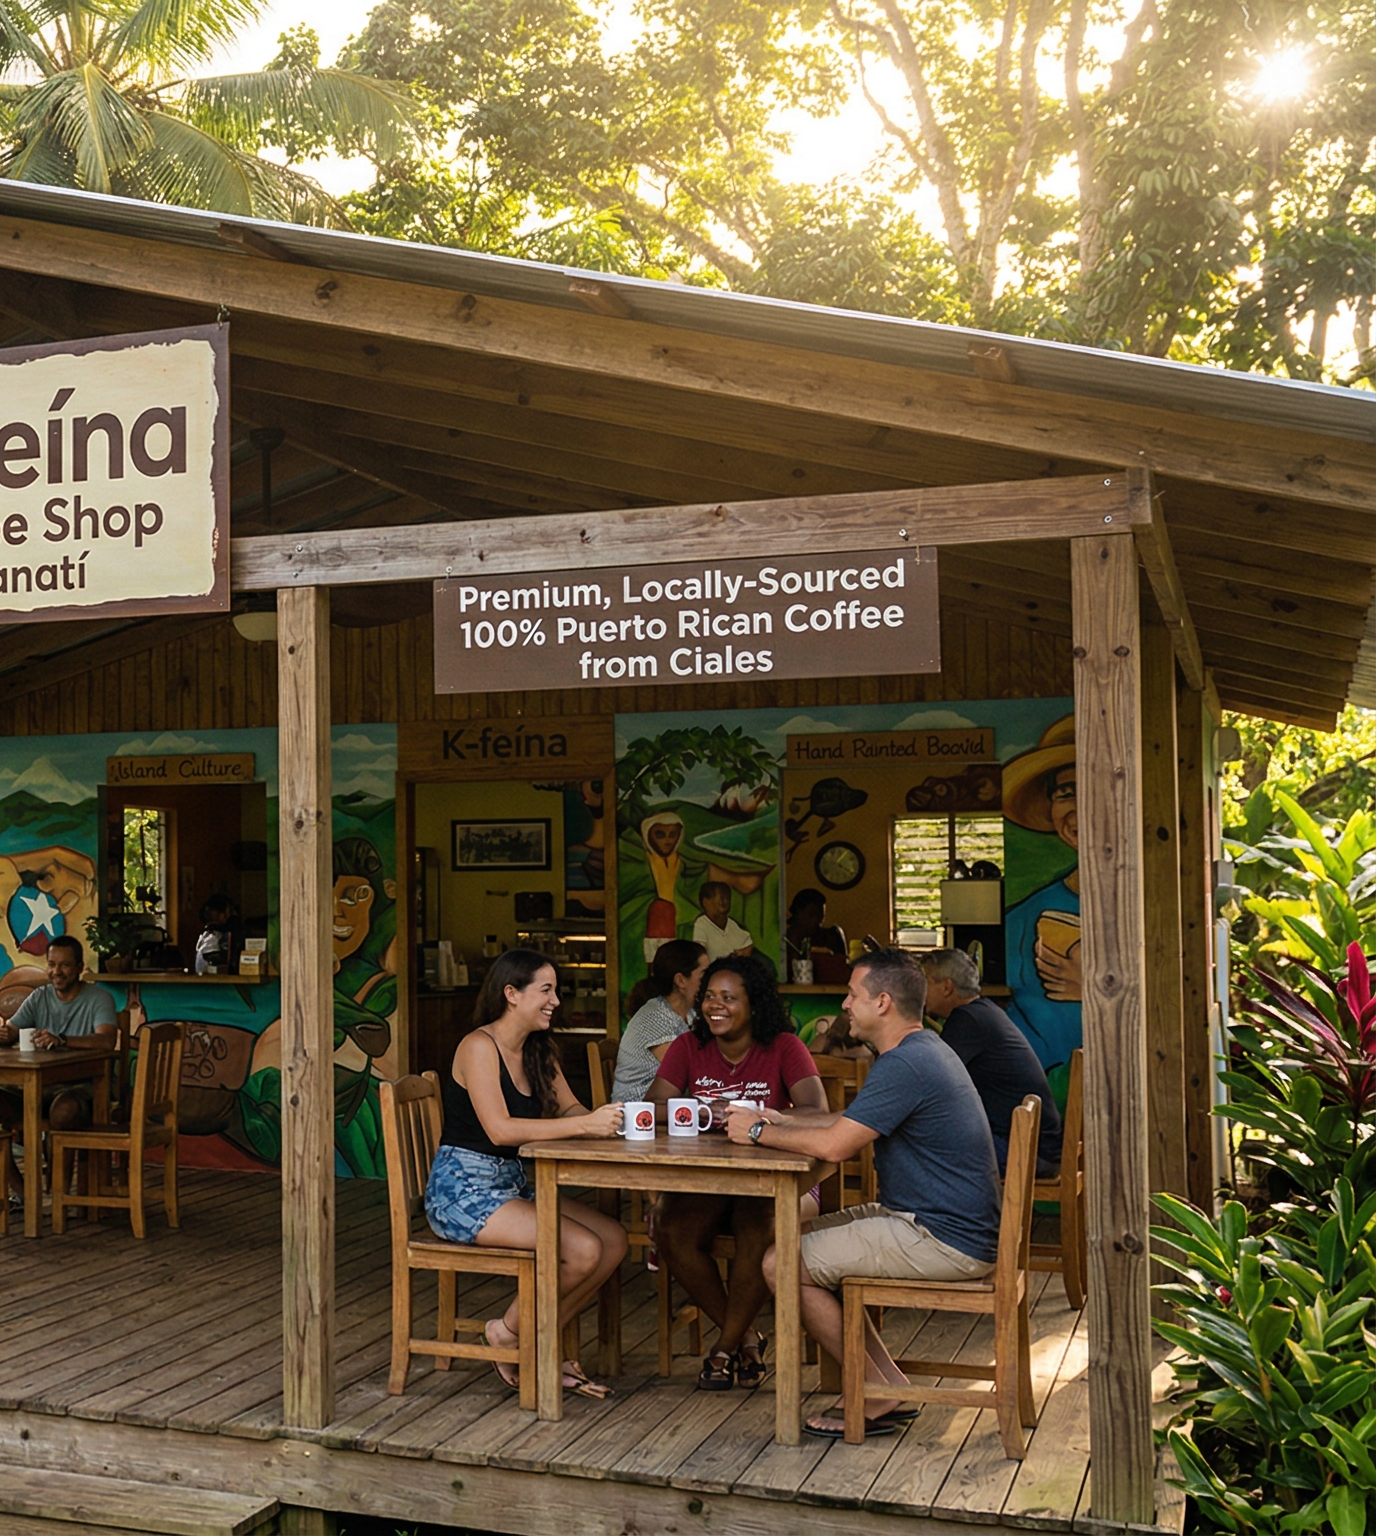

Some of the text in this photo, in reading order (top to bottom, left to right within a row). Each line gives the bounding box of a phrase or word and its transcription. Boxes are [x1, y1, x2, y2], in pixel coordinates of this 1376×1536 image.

[42, 495, 164, 548] Shop
[458, 558, 905, 613] Premium, Locally-Sourced
[460, 600, 905, 649] 100% Puerto Rican Coffee
[579, 645, 774, 679] from Ciales
[443, 724, 567, 760] K-feína
[795, 740, 844, 760] Hand
[117, 757, 242, 780] Island Culture
